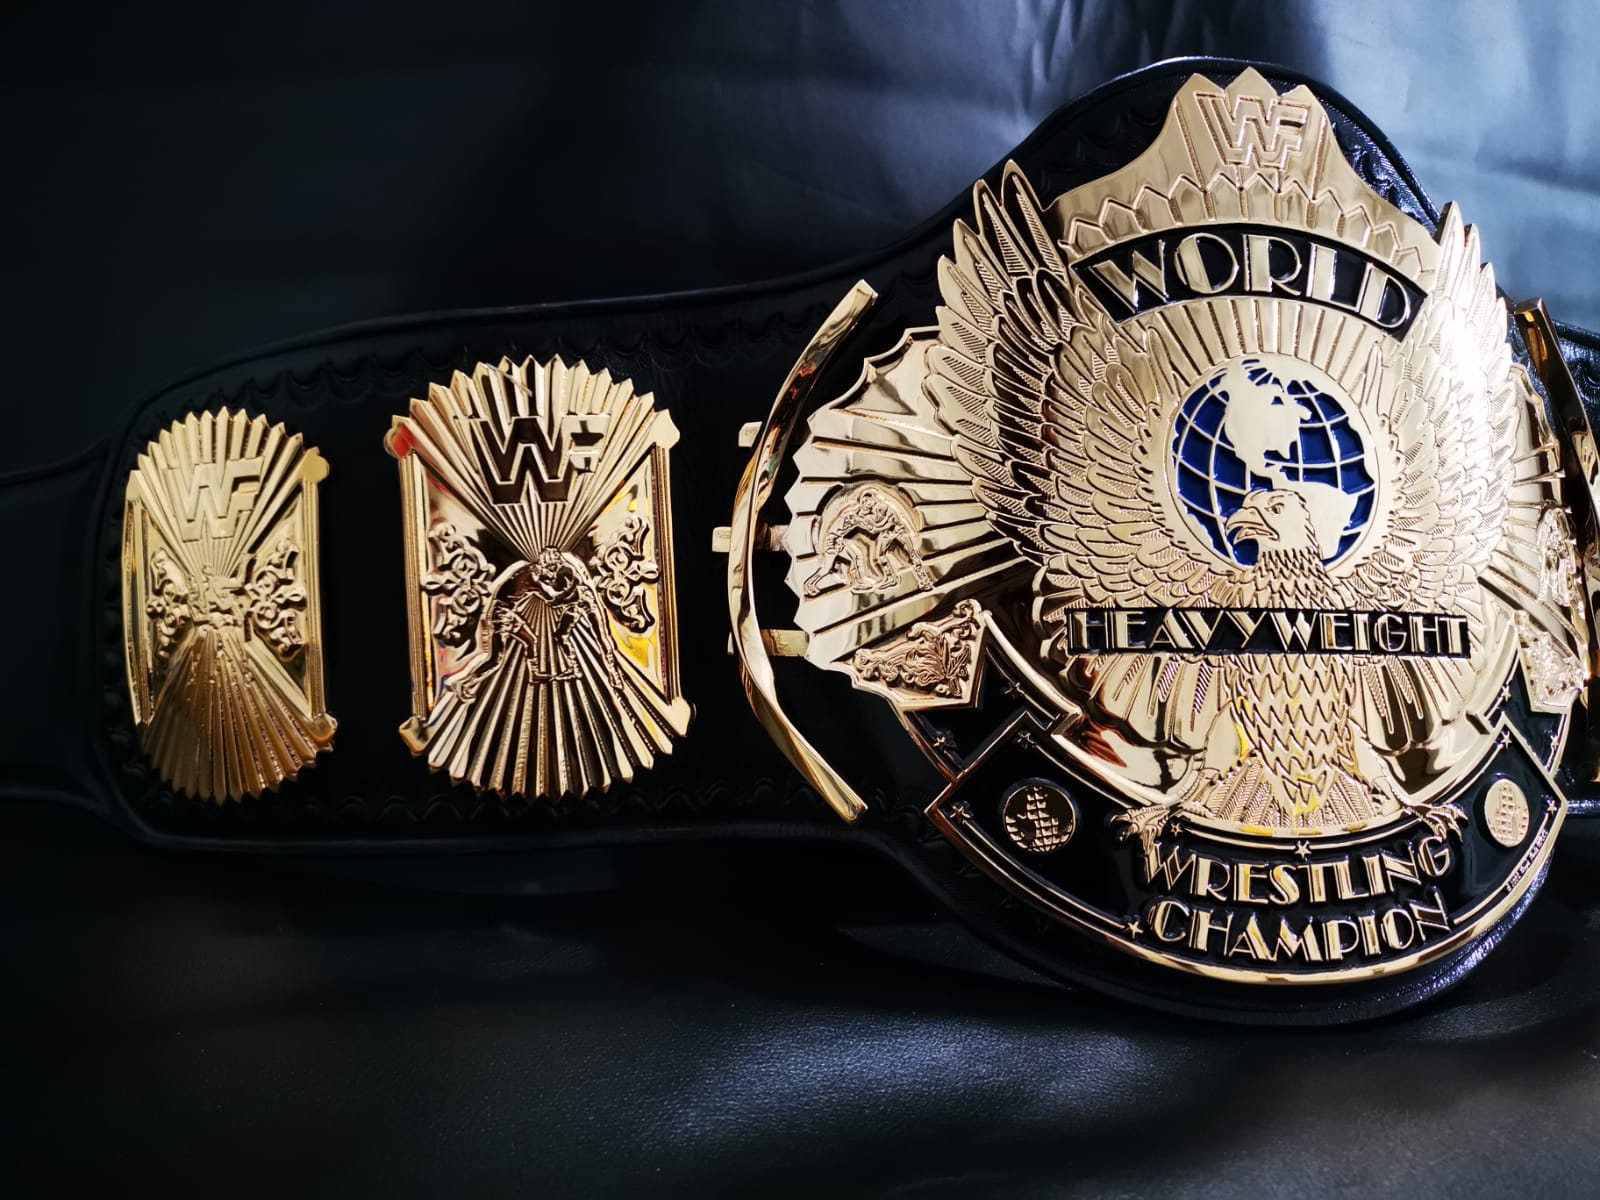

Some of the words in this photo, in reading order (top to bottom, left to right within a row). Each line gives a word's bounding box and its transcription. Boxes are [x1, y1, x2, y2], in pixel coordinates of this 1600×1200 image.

[1091, 233, 1412, 328] WORLD
[1069, 609, 1467, 654] HEAVYWEIGHT
[1146, 837, 1453, 905] WRESTLING
[1149, 888, 1451, 962] CHAMPION
